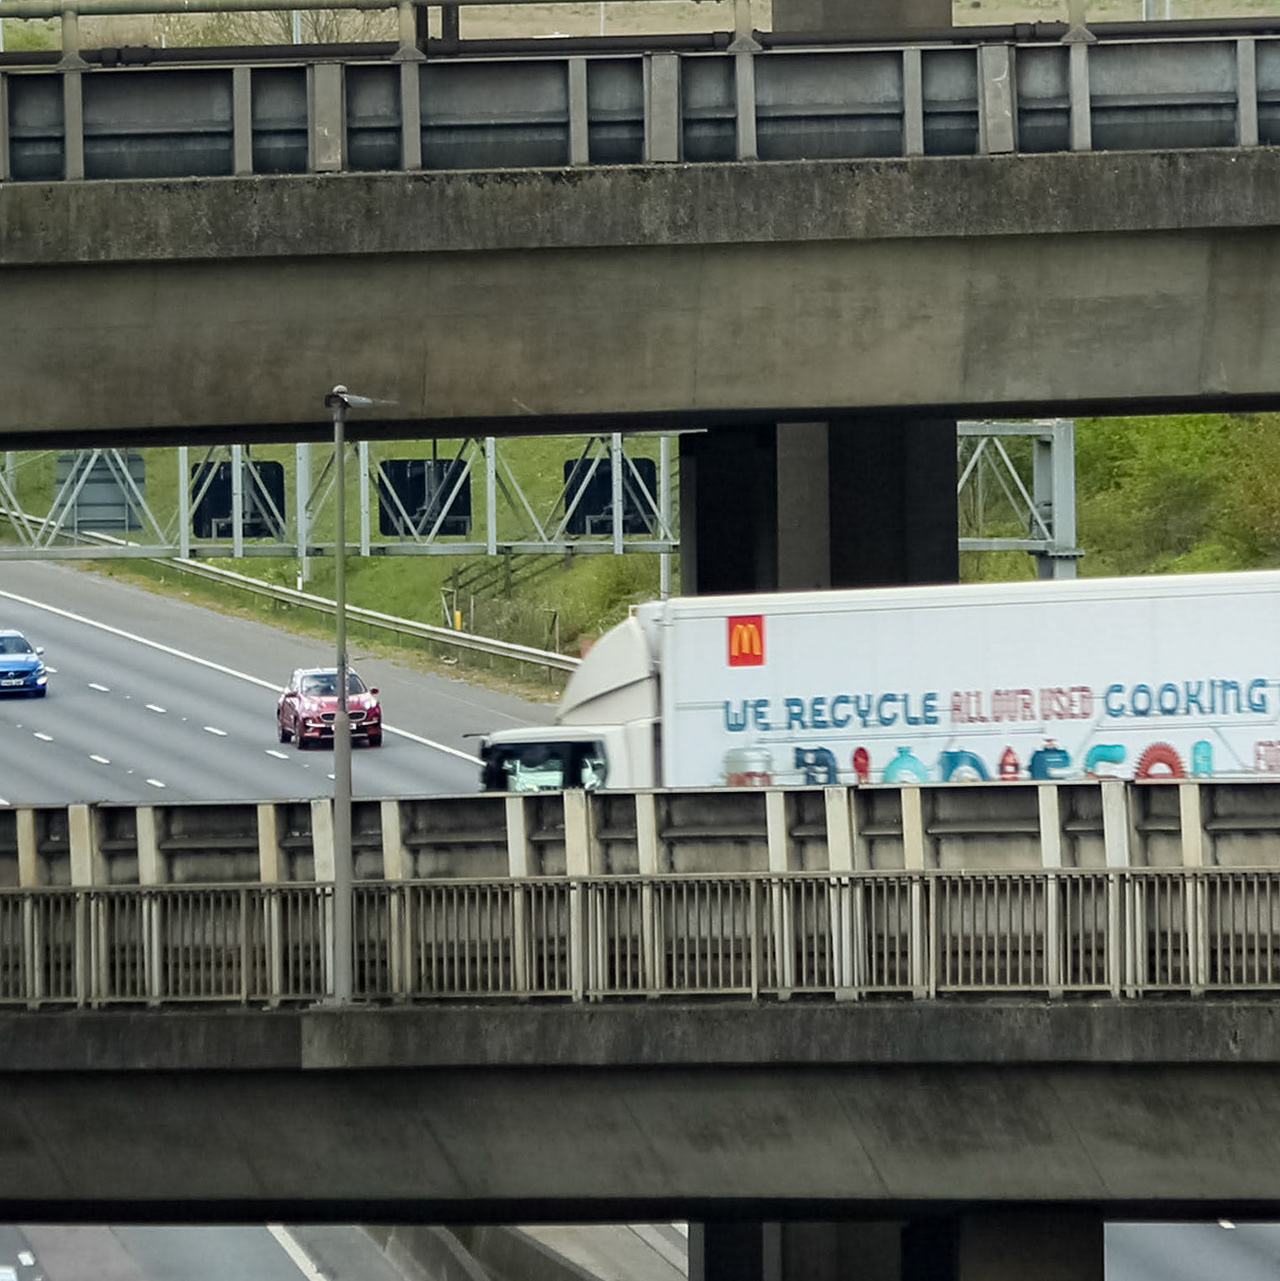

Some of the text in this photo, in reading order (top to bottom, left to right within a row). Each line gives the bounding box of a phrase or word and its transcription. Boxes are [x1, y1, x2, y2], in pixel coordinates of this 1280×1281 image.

[724, 698, 770, 732] WE
[784, 692, 939, 730] RECYCLE
[951, 690, 988, 723] ALL
[1104, 678, 1266, 718] COOKING
